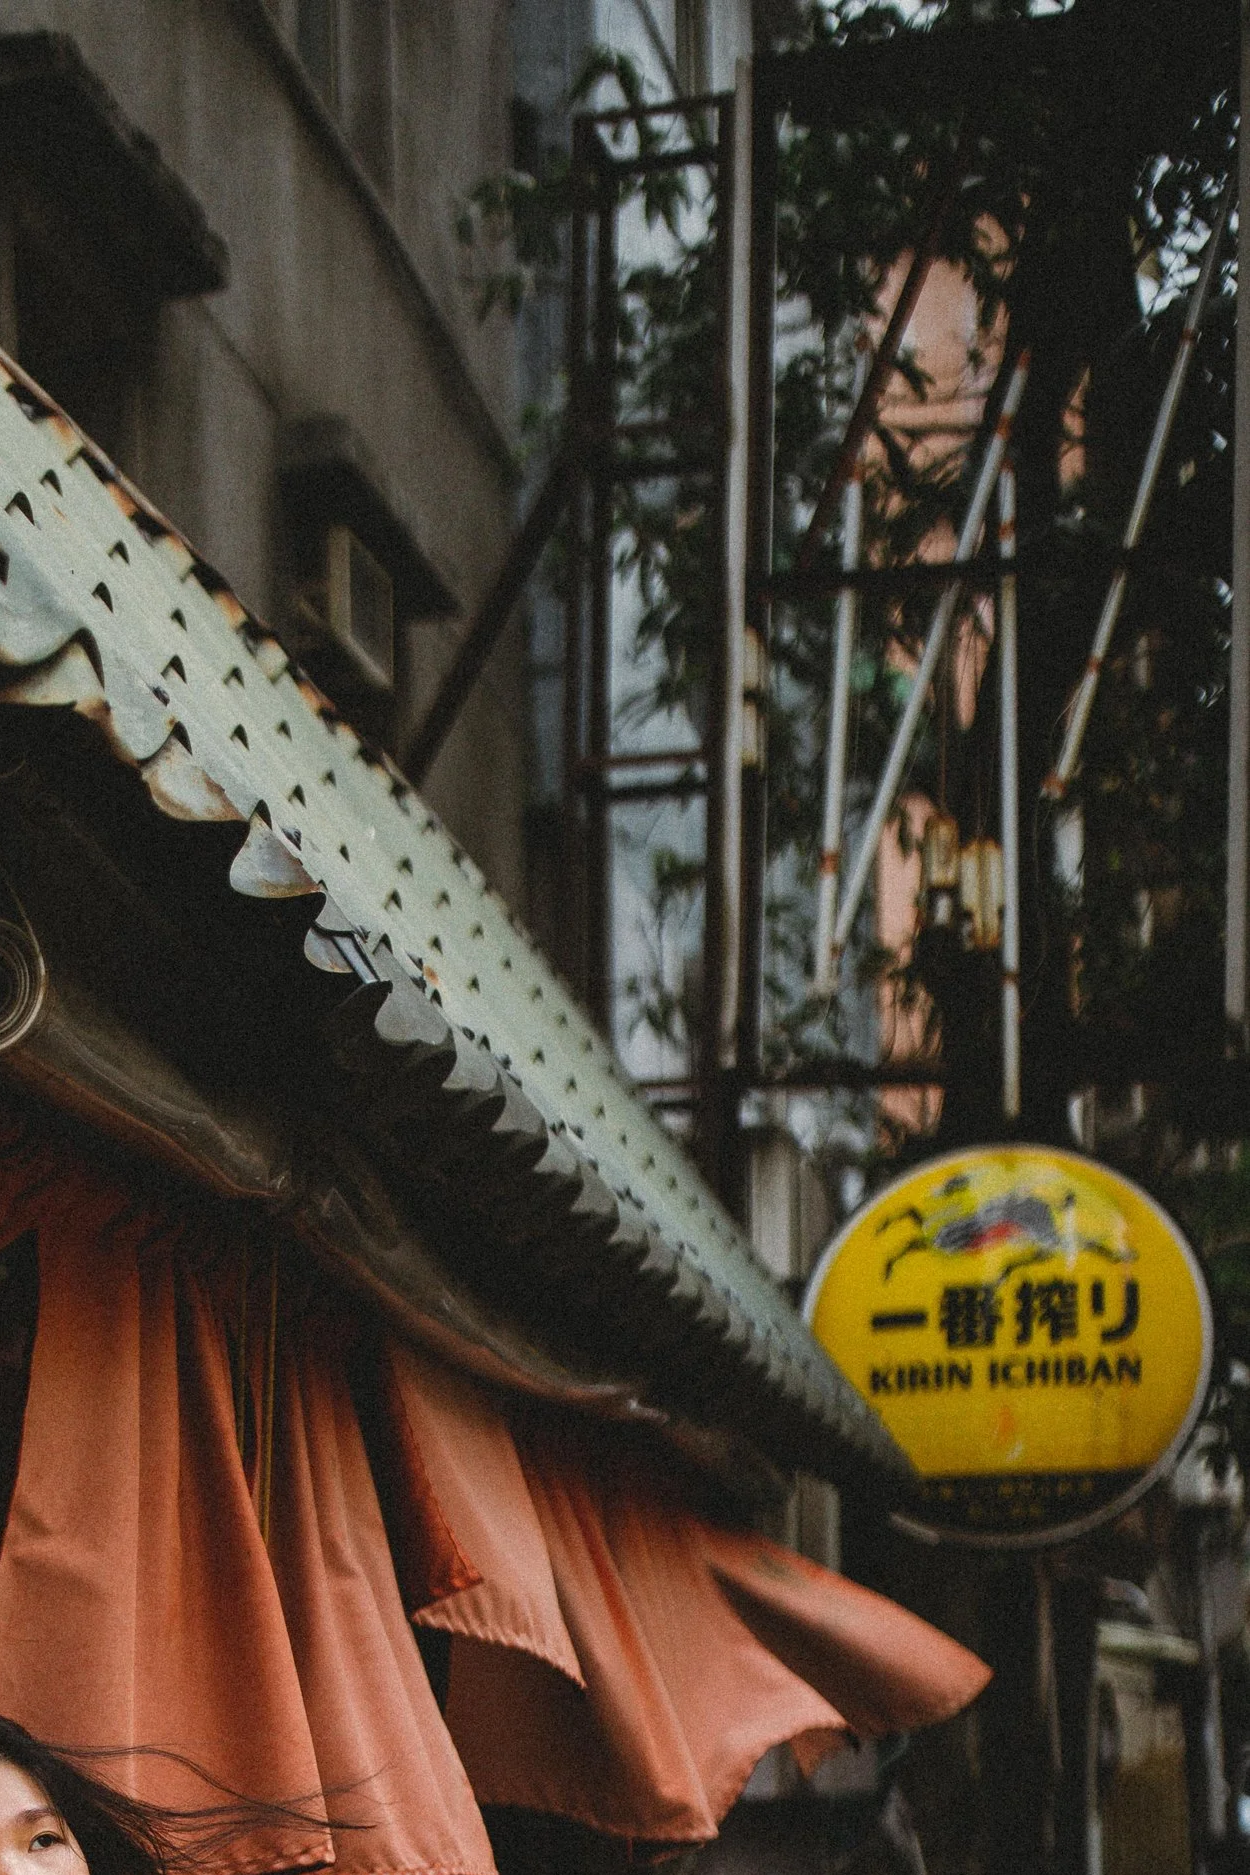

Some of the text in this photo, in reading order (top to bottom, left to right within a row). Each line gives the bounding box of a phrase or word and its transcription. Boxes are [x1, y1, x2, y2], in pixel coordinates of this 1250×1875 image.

[871, 1279, 1140, 1349] 一番搾り
[870, 1353, 1142, 1394] KIRIN ICHIBAN
